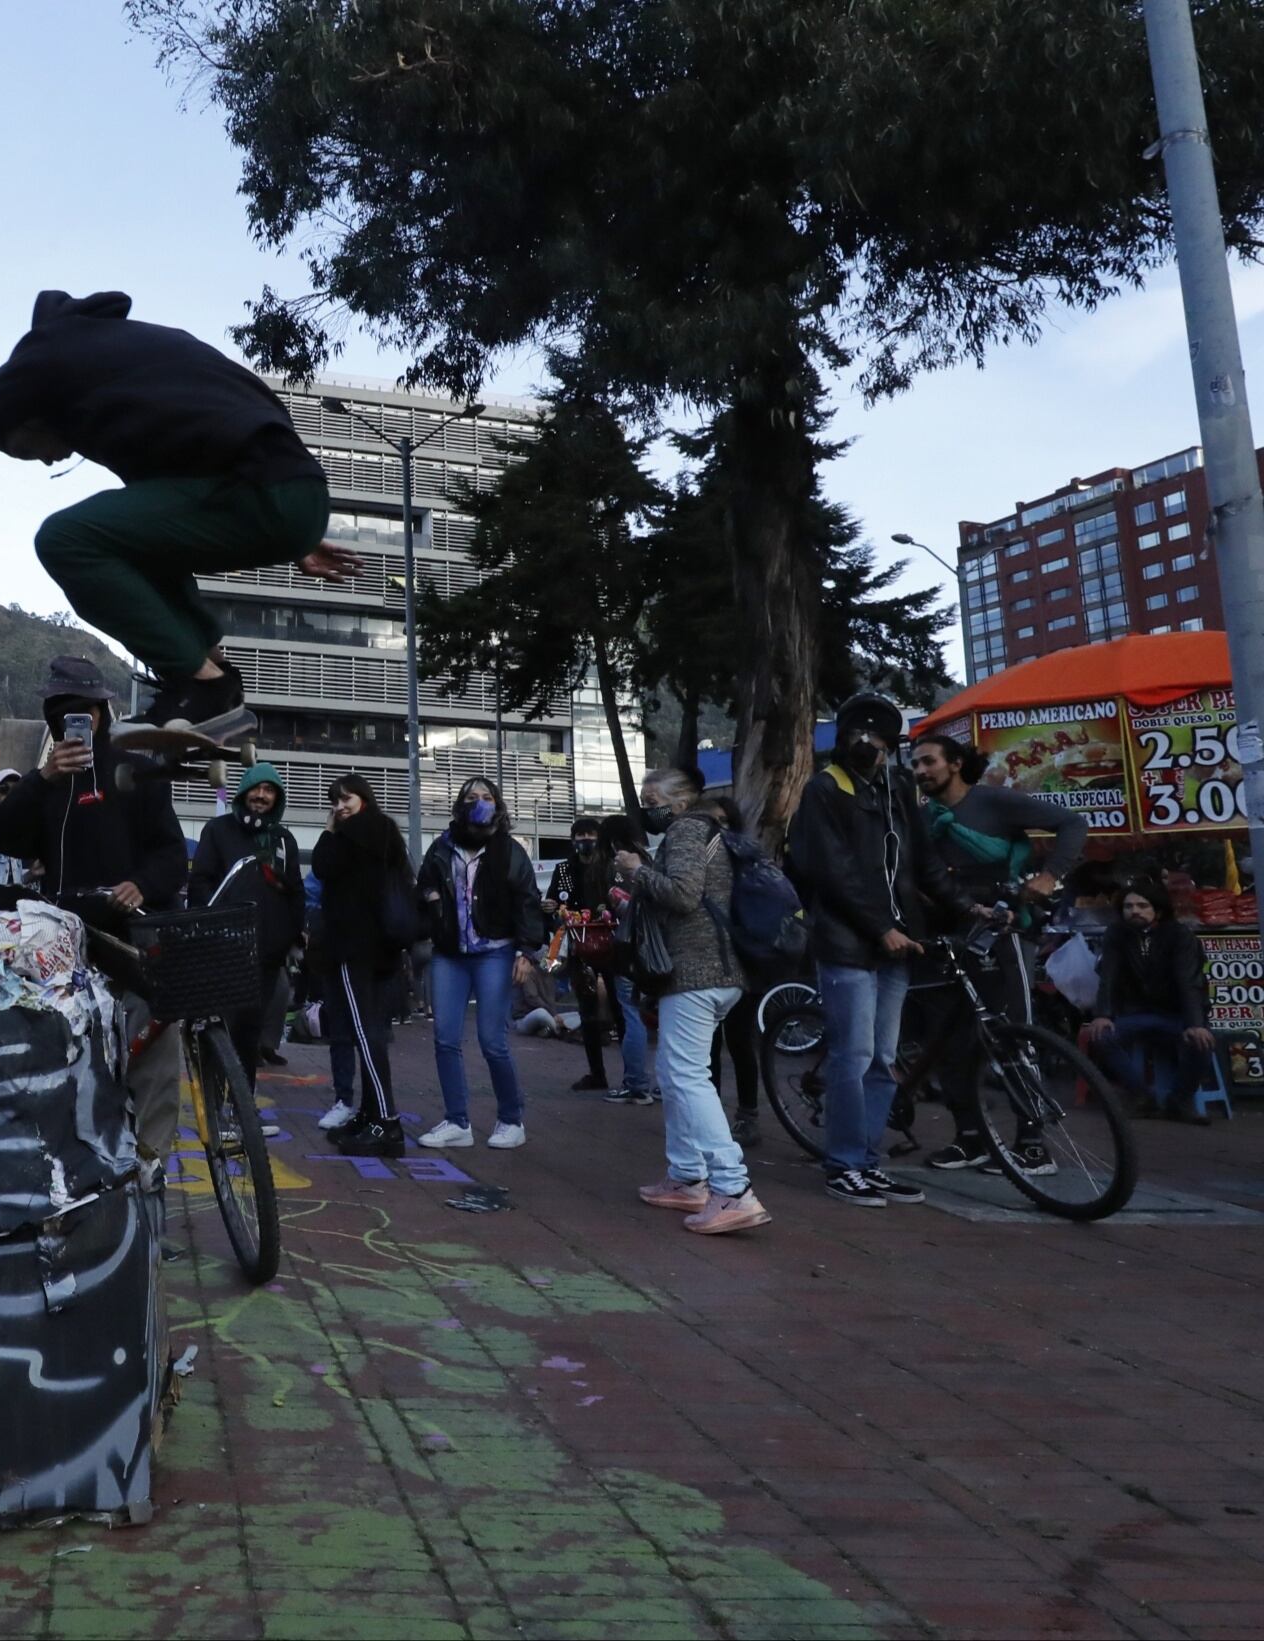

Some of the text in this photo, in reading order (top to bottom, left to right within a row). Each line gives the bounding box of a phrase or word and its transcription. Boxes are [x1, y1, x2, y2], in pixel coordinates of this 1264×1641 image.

[981, 711, 1026, 729] PERRO
[1028, 701, 1117, 724] AMERICANO
[1134, 718, 1170, 728] DOBLE
[1173, 714, 1212, 726] QUESO
[1069, 790, 1124, 807] ESPECIAL
[1222, 952, 1254, 961] QUESO
